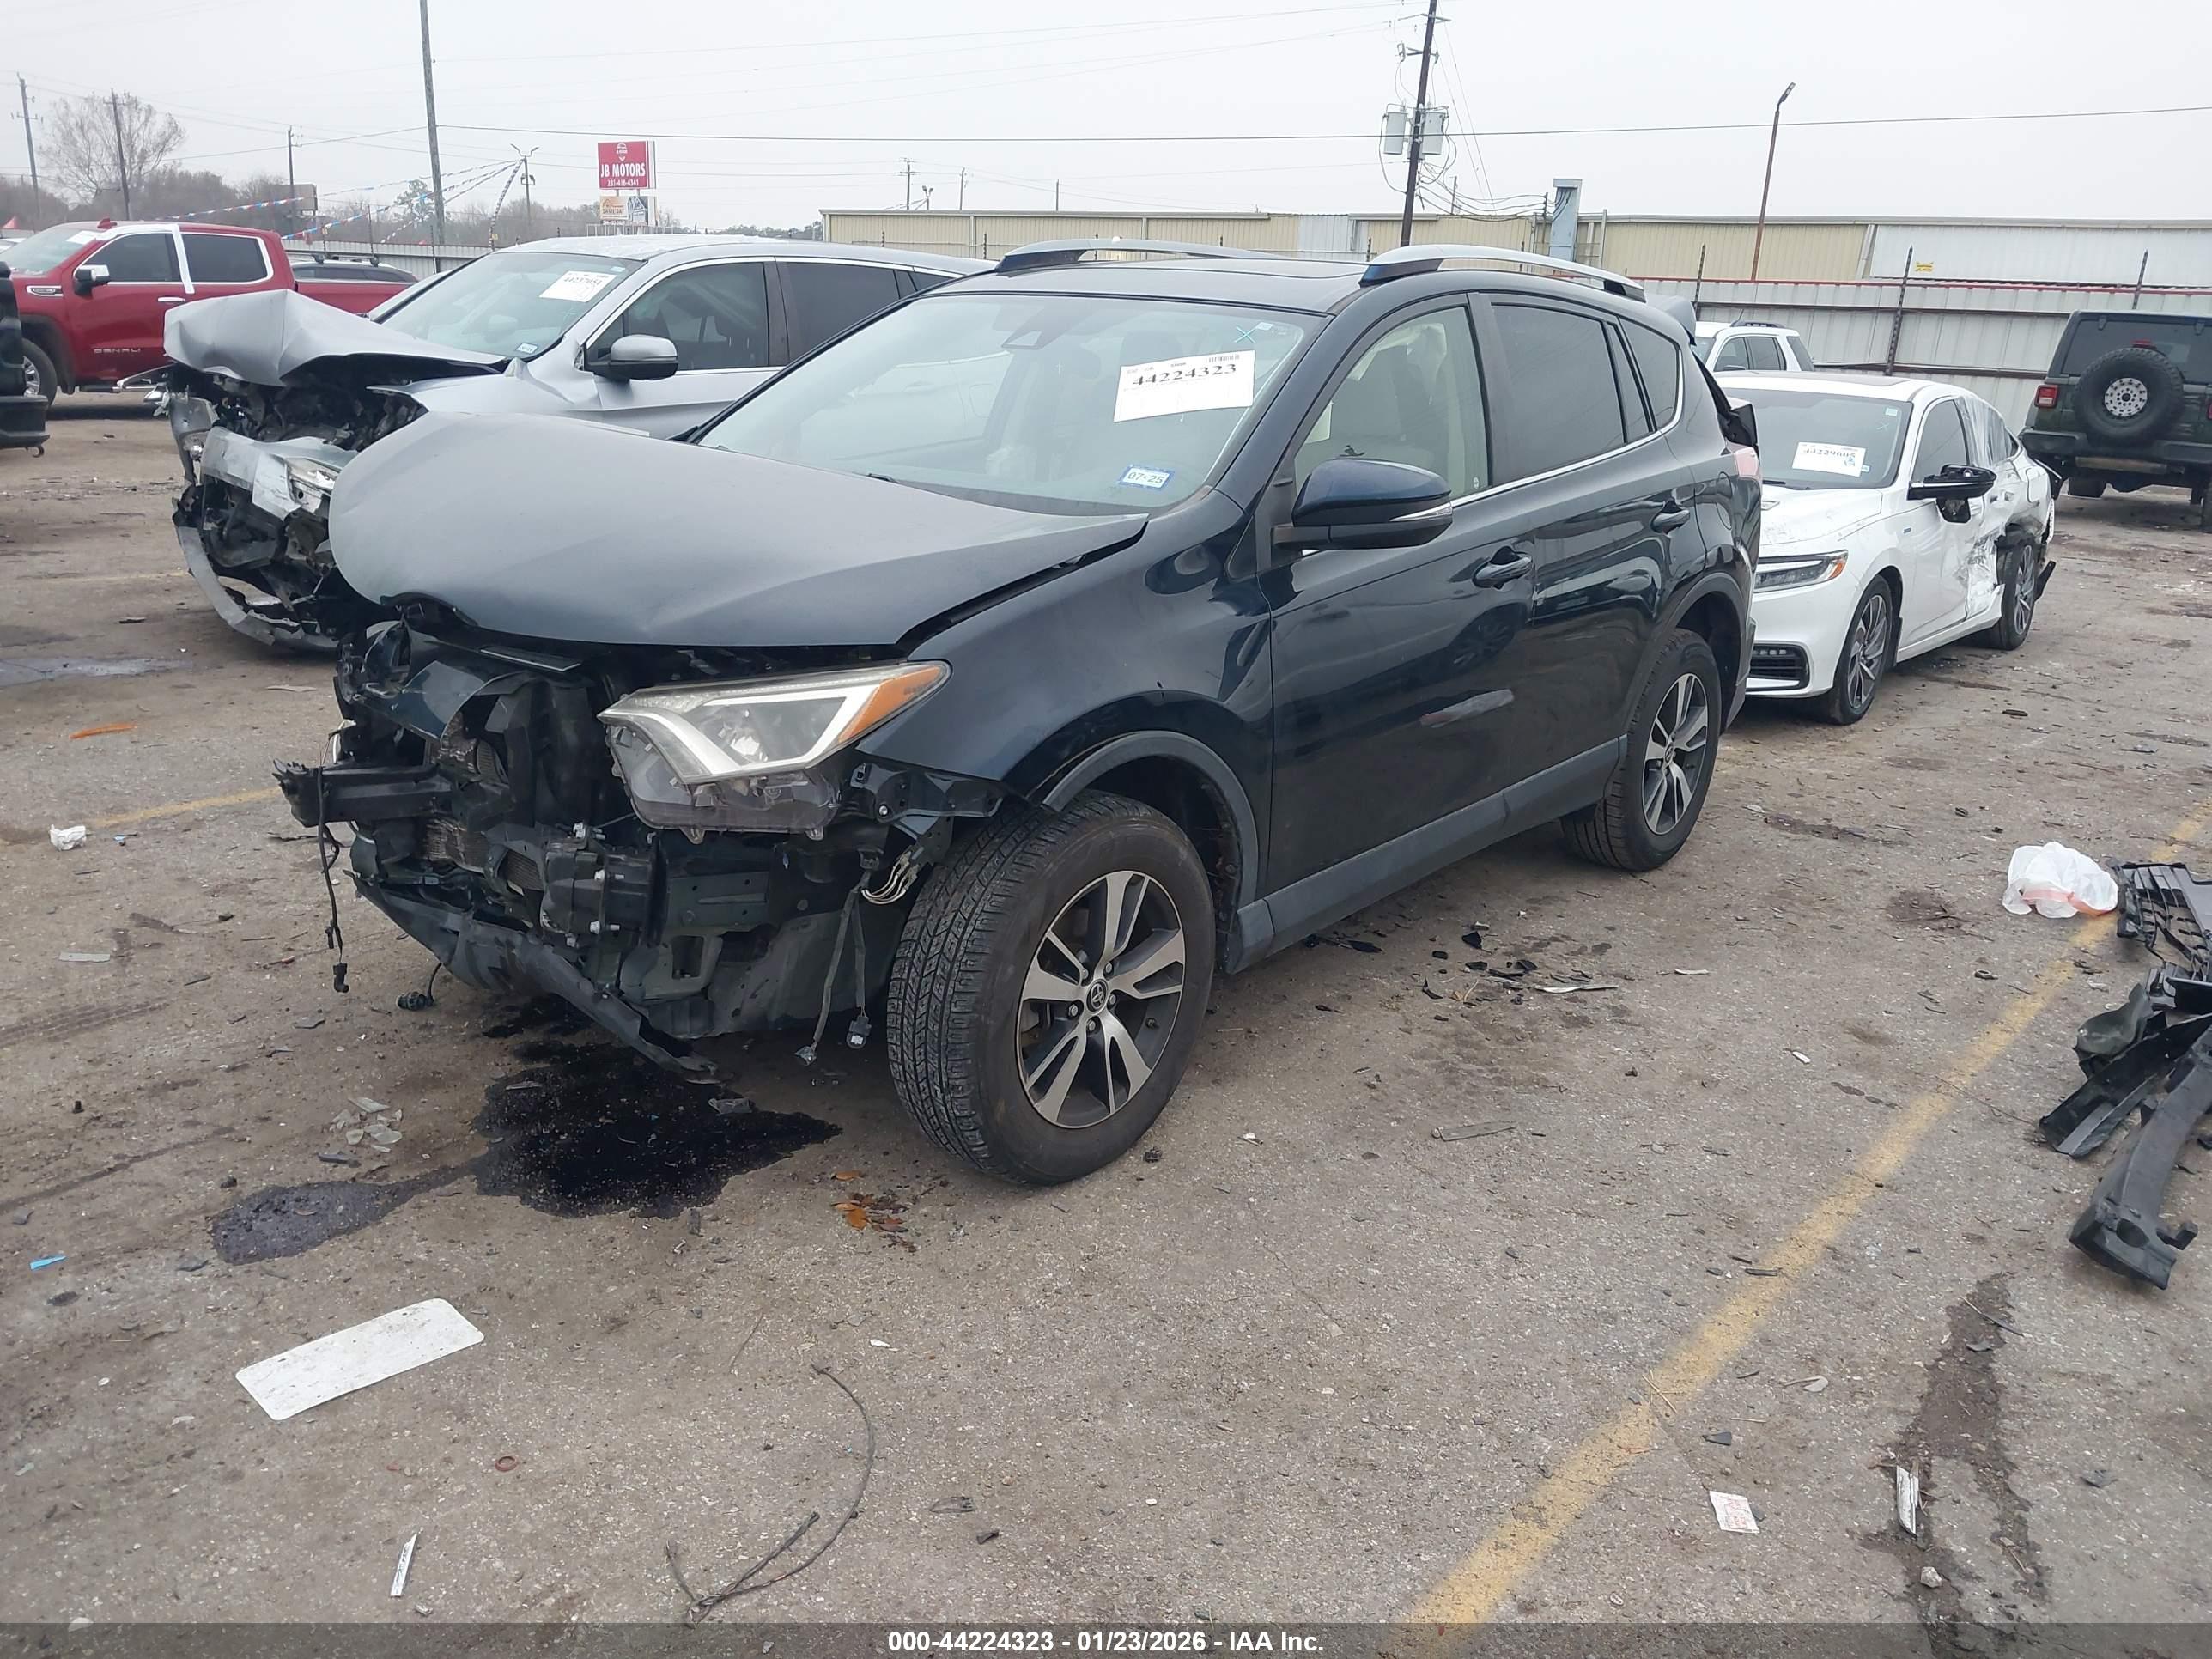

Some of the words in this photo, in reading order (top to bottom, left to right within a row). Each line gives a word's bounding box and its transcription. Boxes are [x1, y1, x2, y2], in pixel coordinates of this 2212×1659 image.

[600, 164, 610, 178] JB
[612, 162, 646, 178] MOTORS
[1133, 363, 1237, 386] 44224323
